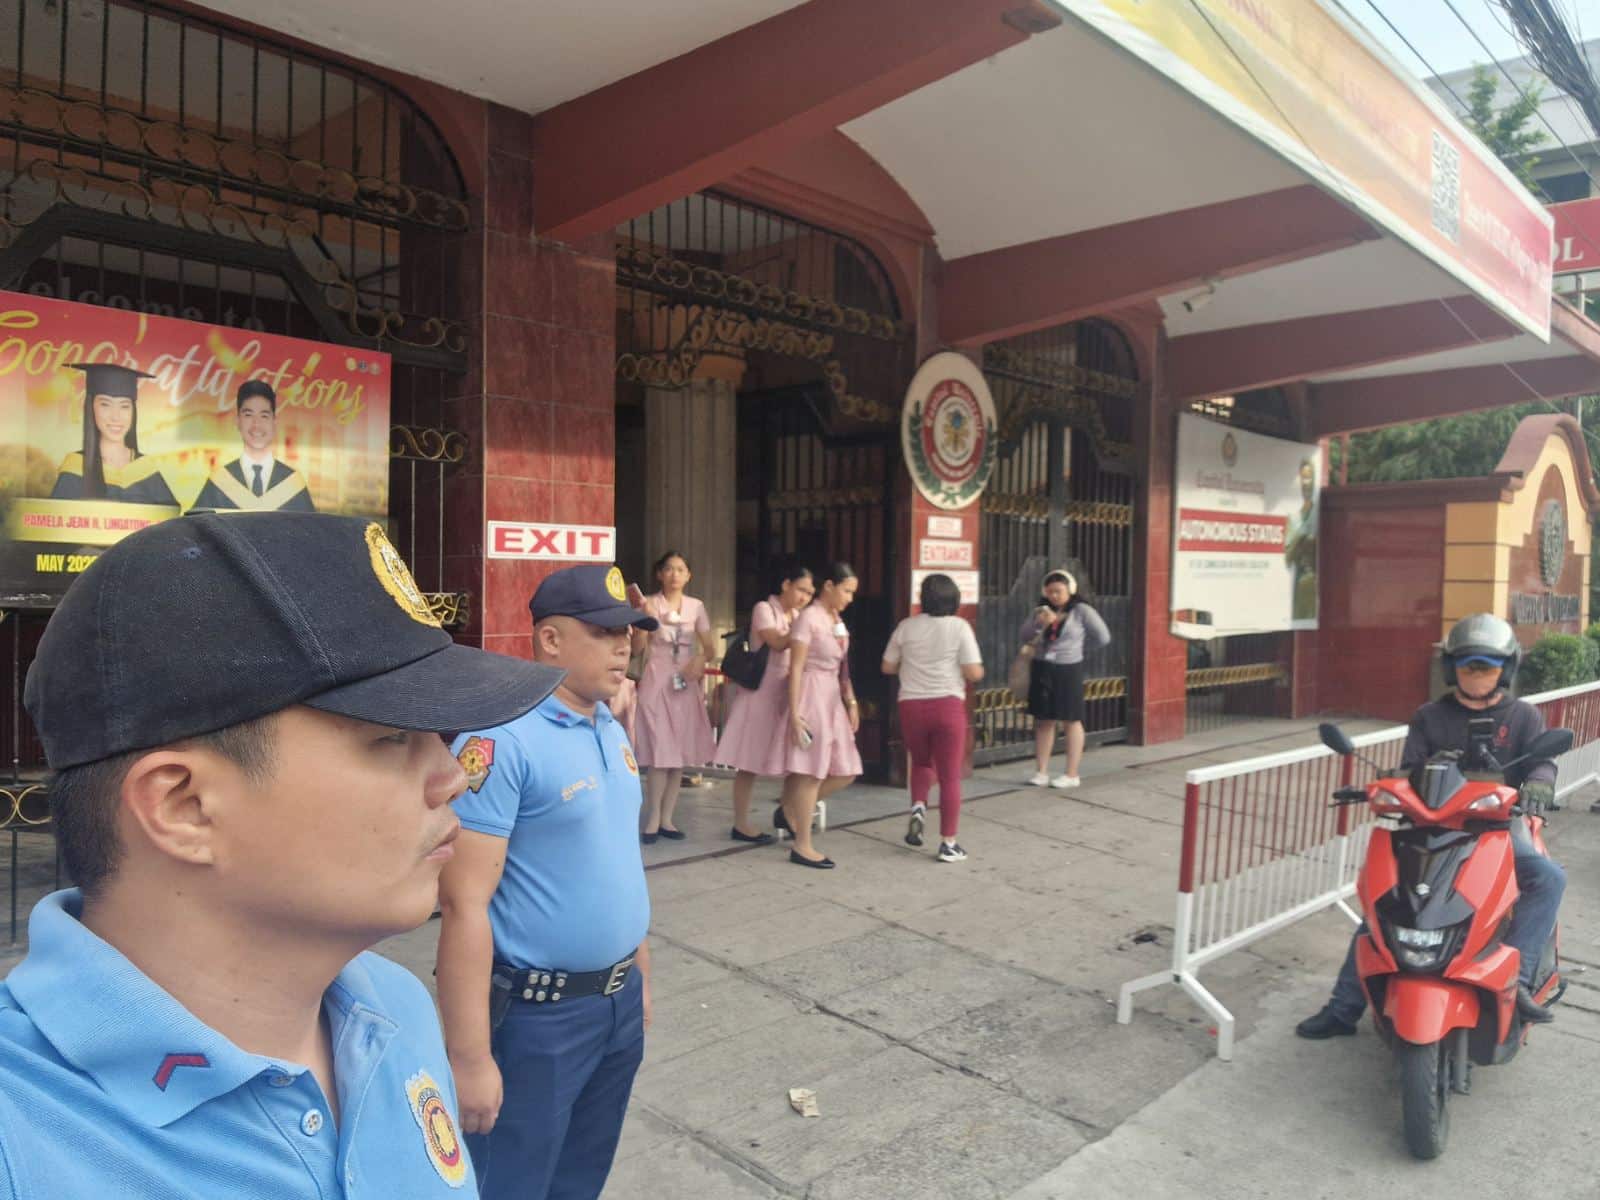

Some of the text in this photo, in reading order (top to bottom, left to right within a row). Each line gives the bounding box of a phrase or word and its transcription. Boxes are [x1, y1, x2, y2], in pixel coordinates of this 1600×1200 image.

[20, 274, 205, 321] elcome
[24, 513, 63, 528] PAMELA
[66, 516, 90, 529] JEAN
[1181, 520, 1283, 544] AUTONOMOUS STATUS
[495, 527, 609, 555] EXIT
[36, 554, 98, 573] MAY 202
